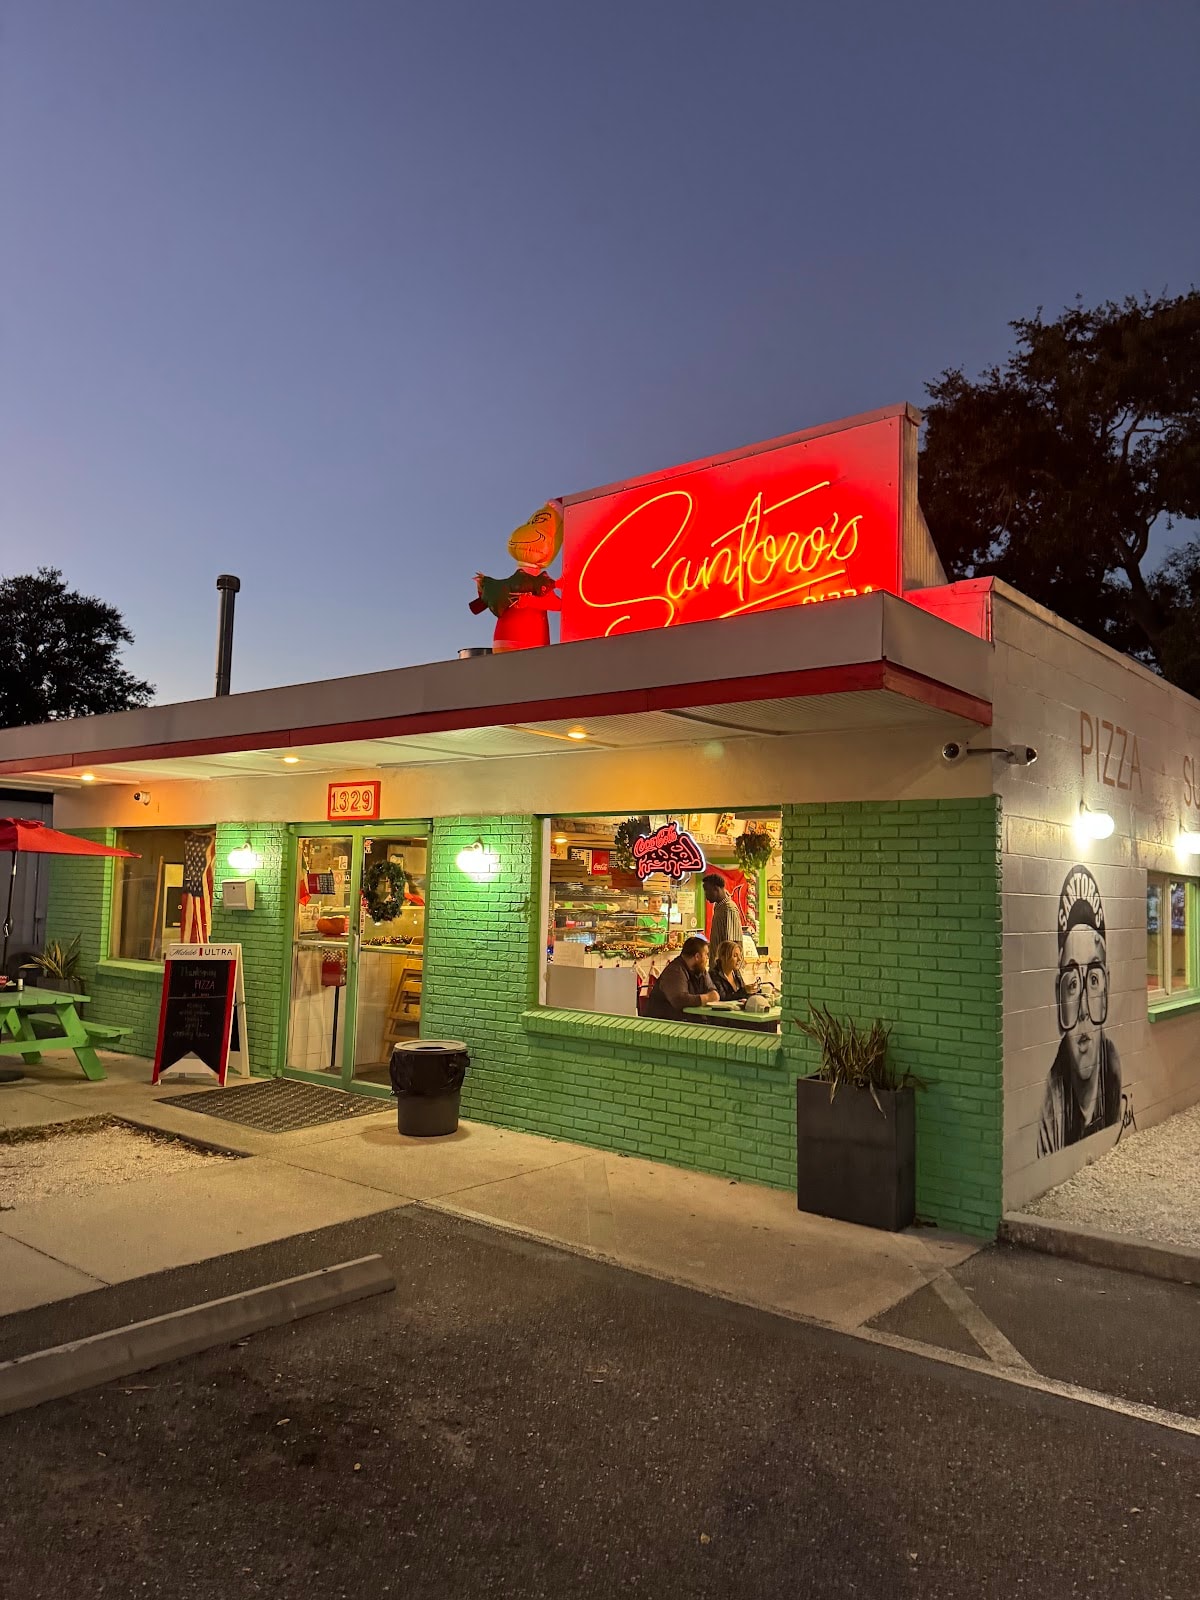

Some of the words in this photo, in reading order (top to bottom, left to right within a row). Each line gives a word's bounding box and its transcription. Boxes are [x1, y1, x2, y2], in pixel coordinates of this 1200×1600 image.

[578, 481, 863, 637] Santoro's
[1080, 710, 1143, 795] PIZZA
[331, 789, 373, 813] 1329
[204, 948, 233, 956] ULTRA
[194, 979, 215, 990] PIZZA
